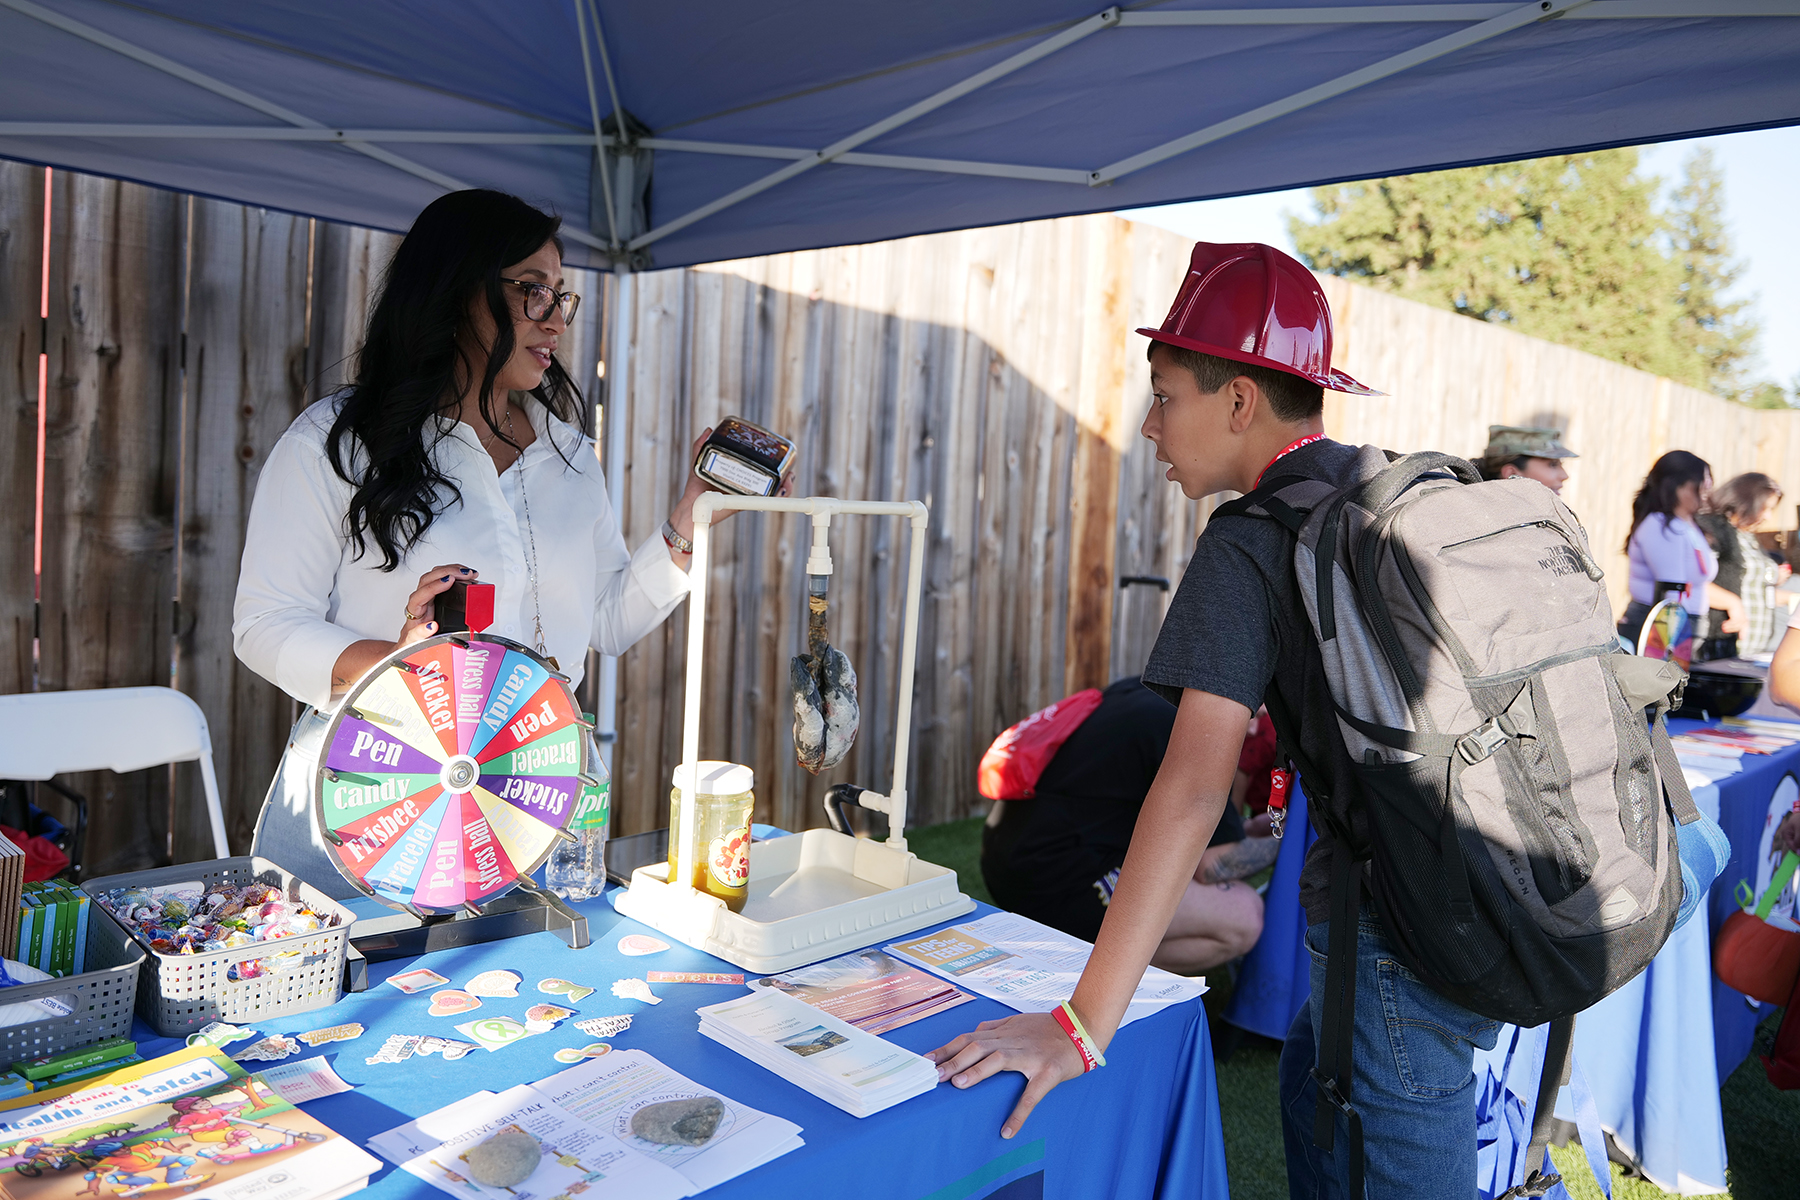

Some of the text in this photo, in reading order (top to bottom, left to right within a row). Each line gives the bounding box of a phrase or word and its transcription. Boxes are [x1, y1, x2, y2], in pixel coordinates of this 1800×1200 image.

[1552, 564, 1574, 577] FACE
[416, 659, 456, 734] Sticker
[457, 647, 491, 724] Stress ball
[482, 663, 533, 733] Candy
[362, 683, 432, 745] Frisbee
[509, 700, 558, 743] Pen
[349, 730, 404, 767] Pen
[511, 740, 578, 777] Bracelet
[333, 778, 411, 810] Candy
[500, 777, 569, 816] Sticker
[345, 799, 420, 863] Frisbee
[485, 803, 541, 858] Candy
[378, 818, 439, 895] Bracelet
[430, 839, 459, 890] Pen
[463, 816, 503, 891] Stress ball
[1506, 849, 1531, 896] RECON
[907, 937, 959, 954] TIPS for
[924, 941, 976, 961] TEENS
[660, 973, 733, 983] FOCUS
[41, 997, 57, 1009] BEST
[53, 1102, 63, 1110] A
[69, 1090, 115, 1105] Guide
[121, 1083, 139, 1091] To
[93, 1094, 132, 1111] and
[137, 1068, 214, 1097] Safety
[582, 1074, 607, 1090] can't
[606, 1060, 640, 1079] control
[34, 1115, 92, 1133] Educational
[93, 1103, 136, 1117] Coloring
[146, 1088, 181, 1104] Activity
[181, 1081, 206, 1093] Book
[439, 1123, 496, 1150] POSITIVE
[495, 1102, 546, 1127] SELF-TALK
[619, 1117, 629, 1134] What
[630, 1098, 650, 1111] can
